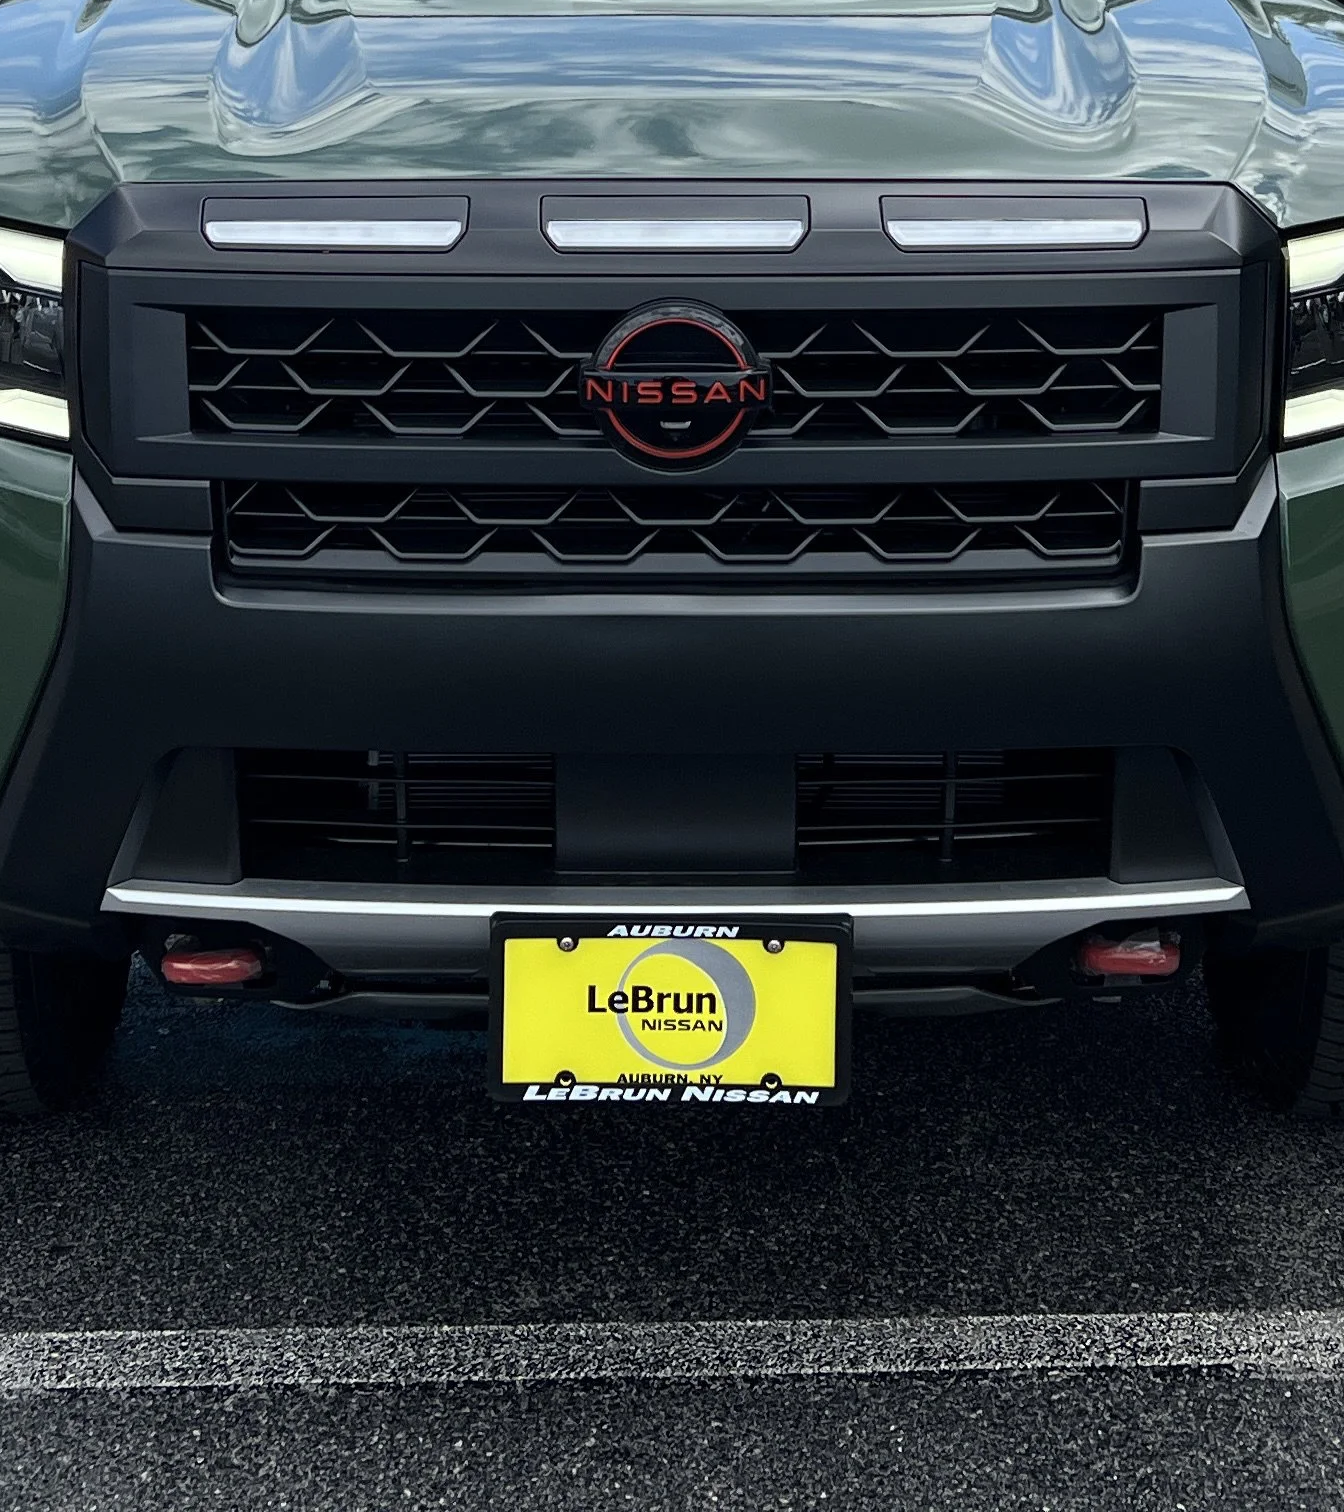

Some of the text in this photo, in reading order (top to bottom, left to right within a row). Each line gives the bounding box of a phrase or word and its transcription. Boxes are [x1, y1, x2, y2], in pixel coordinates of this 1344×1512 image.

[586, 378, 766, 404] NISSAN
[607, 924, 740, 938] AUBURN
[587, 985, 717, 1015] LeBrun
[641, 1019, 724, 1032] NISSAN
[699, 1074, 724, 1086] NY
